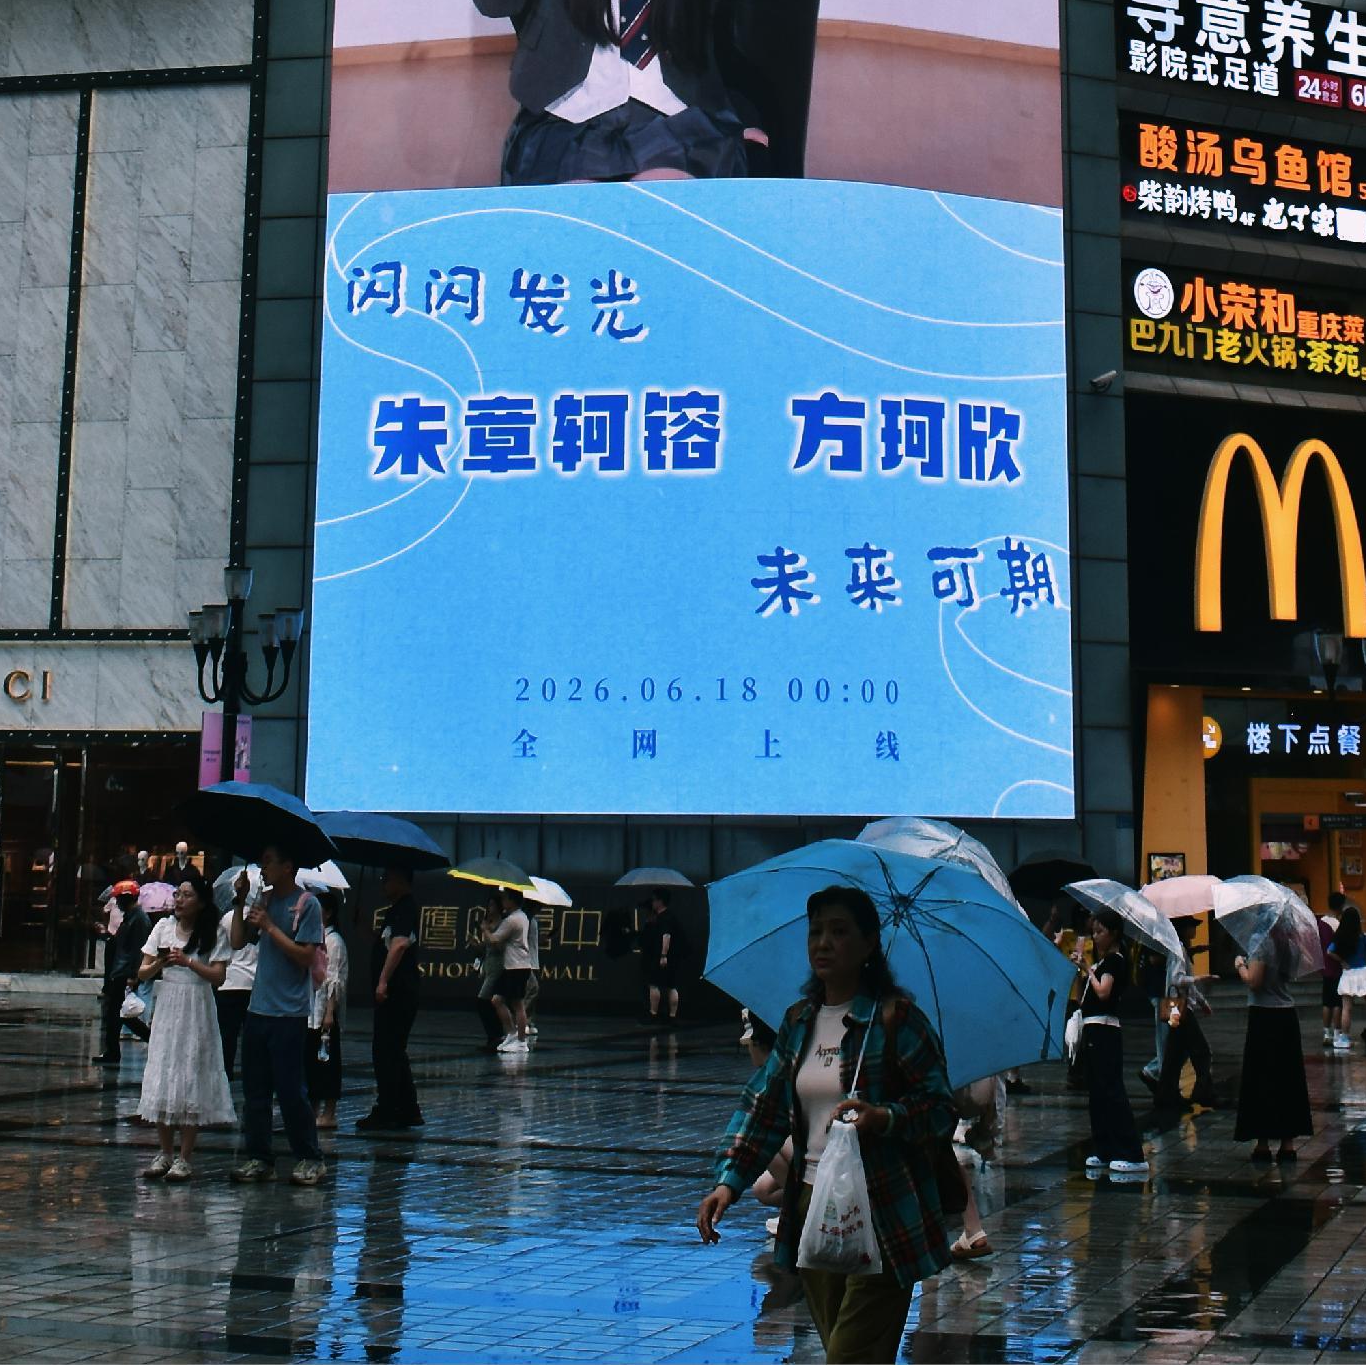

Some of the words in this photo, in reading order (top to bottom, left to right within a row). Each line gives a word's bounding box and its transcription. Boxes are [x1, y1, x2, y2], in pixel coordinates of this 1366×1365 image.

[1129, 39, 1280, 97] 影院式足道
[1298, 75, 1322, 100] 24
[1138, 123, 1353, 199] 酸汤乌鱼馆
[1138, 180, 1238, 223] 柴韵烤鸭
[1239, 211, 1257, 227] 4F
[346, 261, 648, 342] 闪闪发光
[371, 389, 722, 478] 朱章轲镕
[791, 391, 1023, 484] 方珂欣
[751, 535, 1061, 616] 未来可期
[515, 676, 759, 704] 2026.06.18
[787, 677, 901, 705] 00:00
[511, 727, 902, 762] 全网上线
[1246, 721, 1362, 756] 楼下点餐
